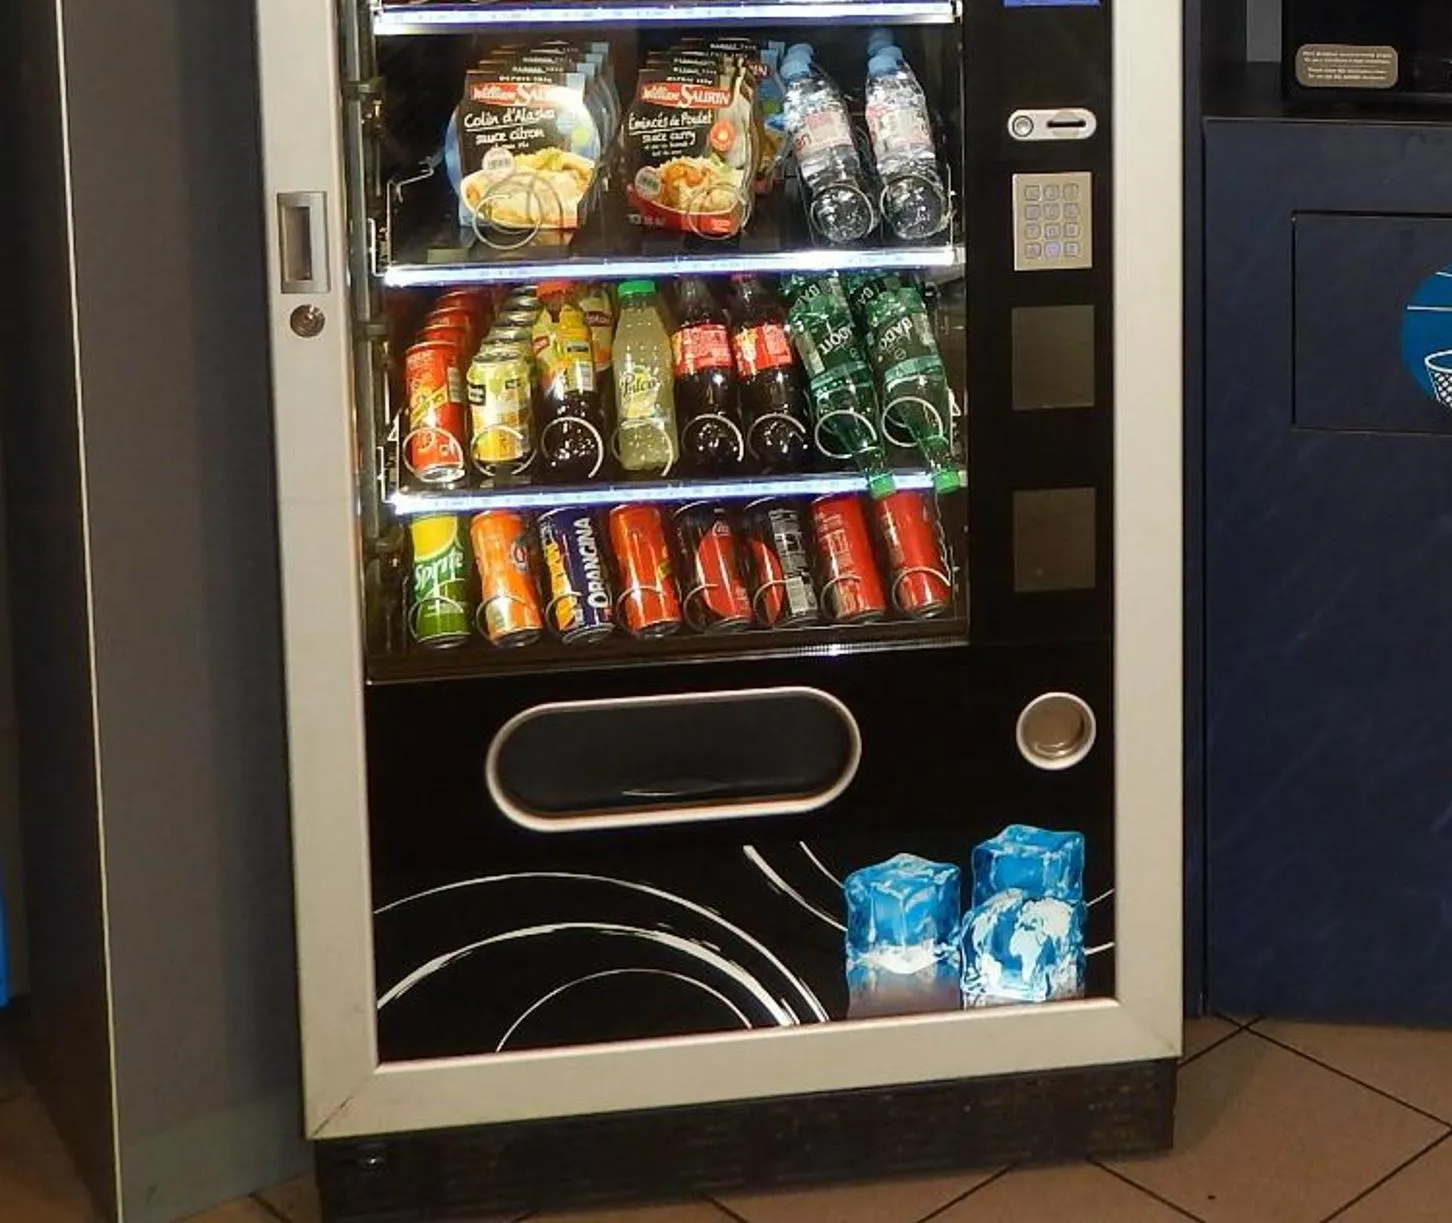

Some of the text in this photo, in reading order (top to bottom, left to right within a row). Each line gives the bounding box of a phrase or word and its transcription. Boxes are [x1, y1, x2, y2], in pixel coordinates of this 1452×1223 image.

[464, 111, 499, 128] Colin
[476, 126, 545, 145] sauce citron
[414, 551, 464, 591] Sprite
[572, 517, 605, 609] ORANGINA
